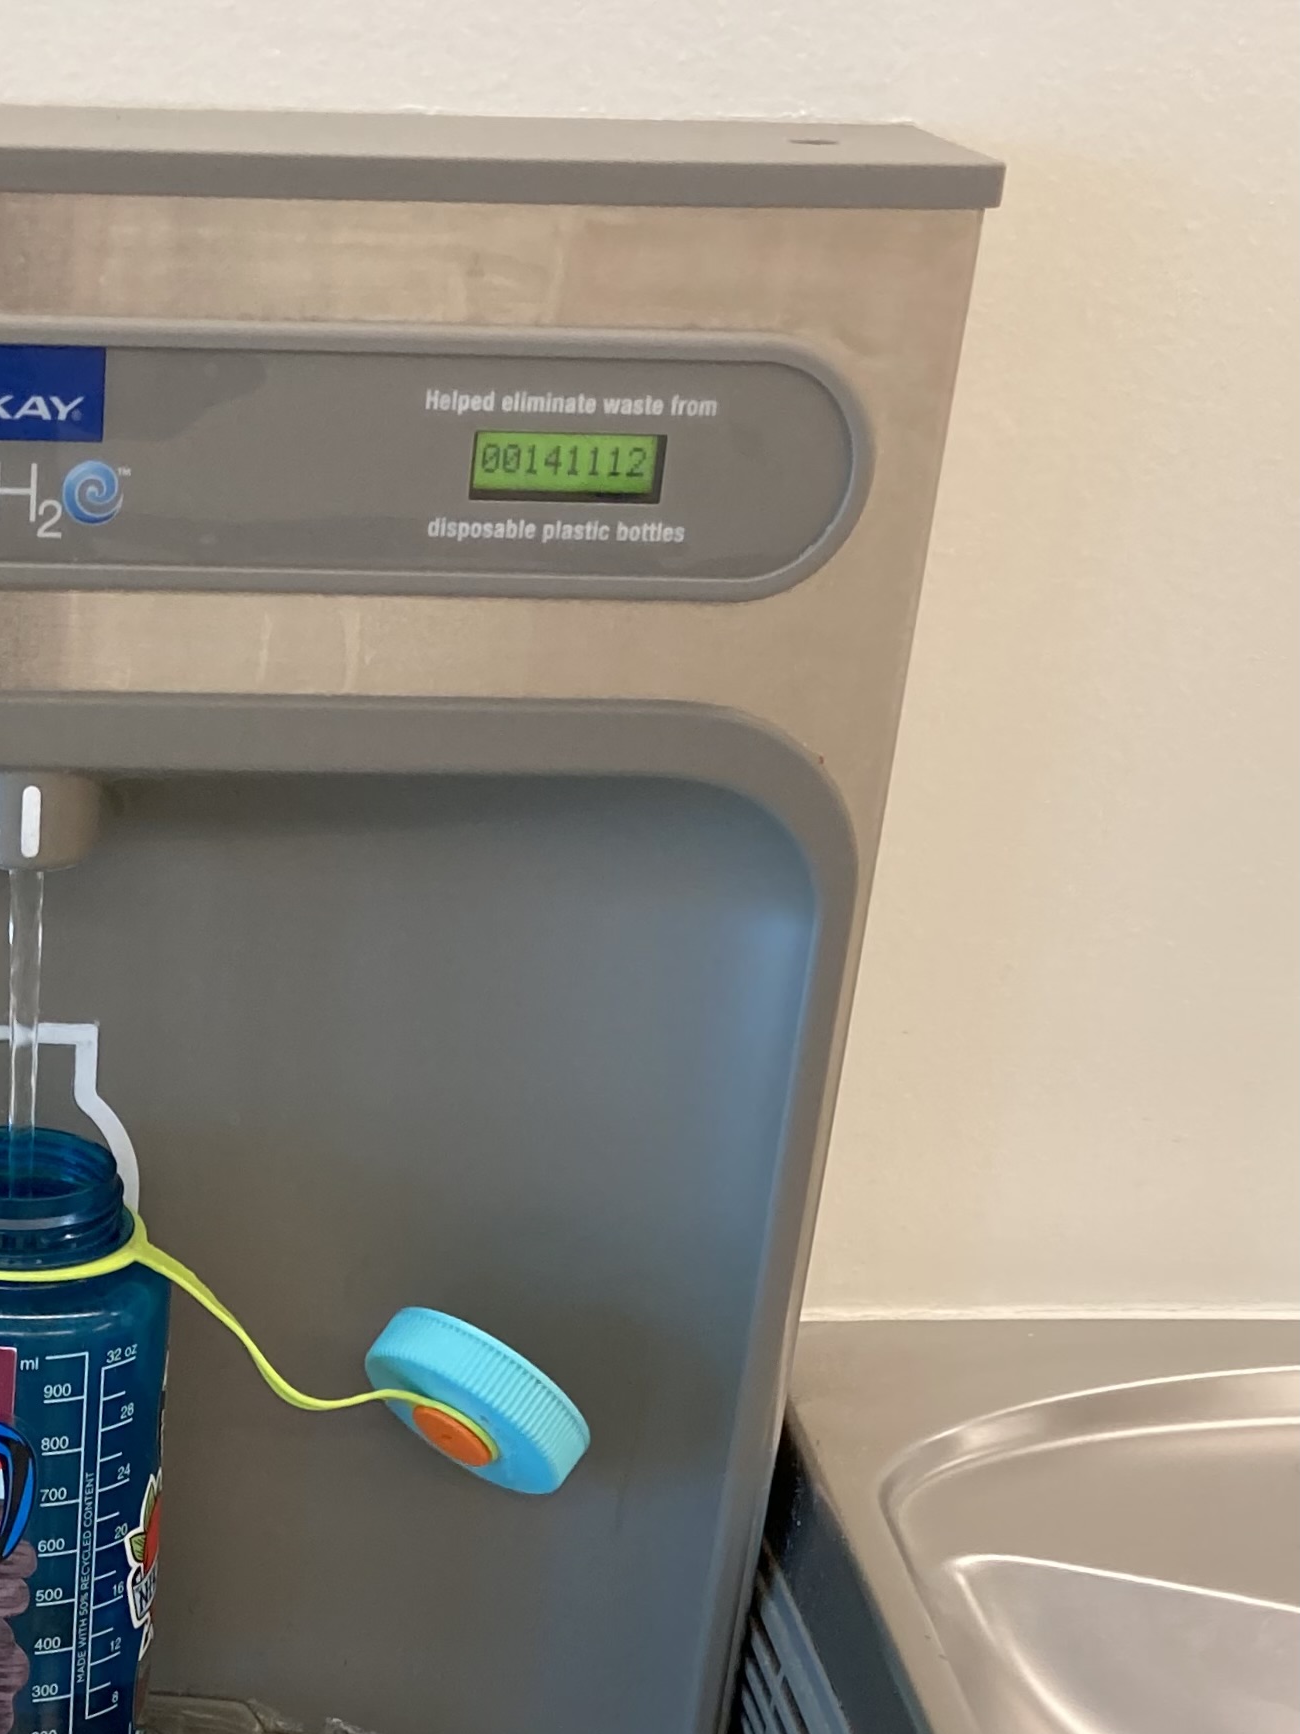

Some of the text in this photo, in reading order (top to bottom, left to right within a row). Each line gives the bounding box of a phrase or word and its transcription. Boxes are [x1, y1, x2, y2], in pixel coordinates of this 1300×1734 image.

[425, 389, 718, 417] Helped eliminate waste from
[480, 442, 648, 478] 00141112
[427, 517, 686, 543] disposable plastic bottles
[106, 1344, 138, 1363] 32 oz
[19, 1357, 40, 1371] ml
[43, 1383, 72, 1398] 900
[120, 1403, 135, 1419] 28
[40, 1436, 70, 1451] 800
[117, 1463, 131, 1479] 24
[39, 1488, 67, 1502] 700
[114, 1523, 128, 1539] 20
[37, 1538, 66, 1553] 600
[76, 1471, 95, 1684] MADE WITH 50% RECYCLED CONTENT
[35, 1588, 63, 1602] 500
[112, 1581, 125, 1597] 16
[34, 1636, 62, 1651] 400
[110, 1637, 122, 1652] 12
[31, 1683, 59, 1698] 300
[110, 1690, 119, 1704] 8
